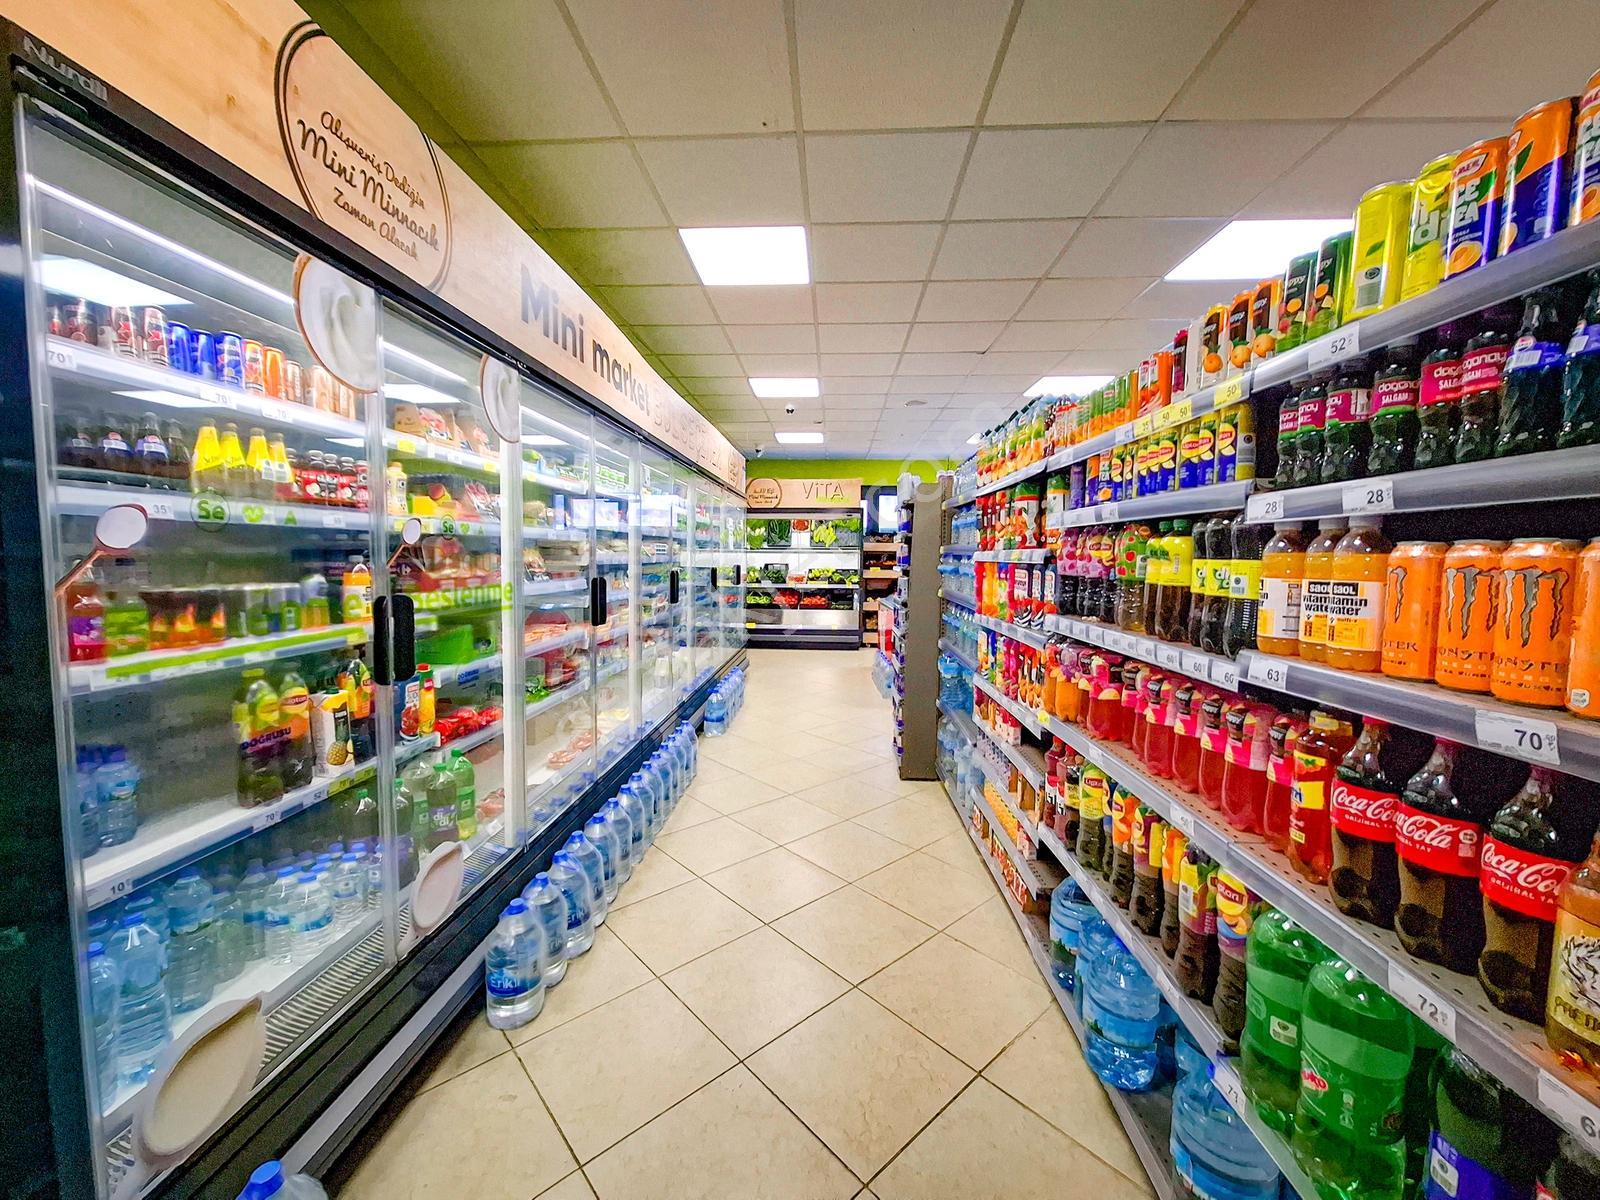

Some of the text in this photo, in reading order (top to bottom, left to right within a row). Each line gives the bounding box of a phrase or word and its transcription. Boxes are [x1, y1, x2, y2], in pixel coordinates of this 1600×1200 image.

[297, 119, 357, 188] Mini
[333, 186, 376, 232] Zaman
[520, 263, 651, 417] Mini market
[1330, 337, 1346, 354] 52
[1226, 387, 1237, 398] 50
[1366, 488, 1384, 505] 28
[1265, 501, 1278, 514] 28
[1224, 671, 1235, 683] 60
[1267, 668, 1280, 682] 63
[1514, 729, 1543, 751] 70
[110, 882, 126, 895] 10
[1418, 993, 1440, 1025] 72
